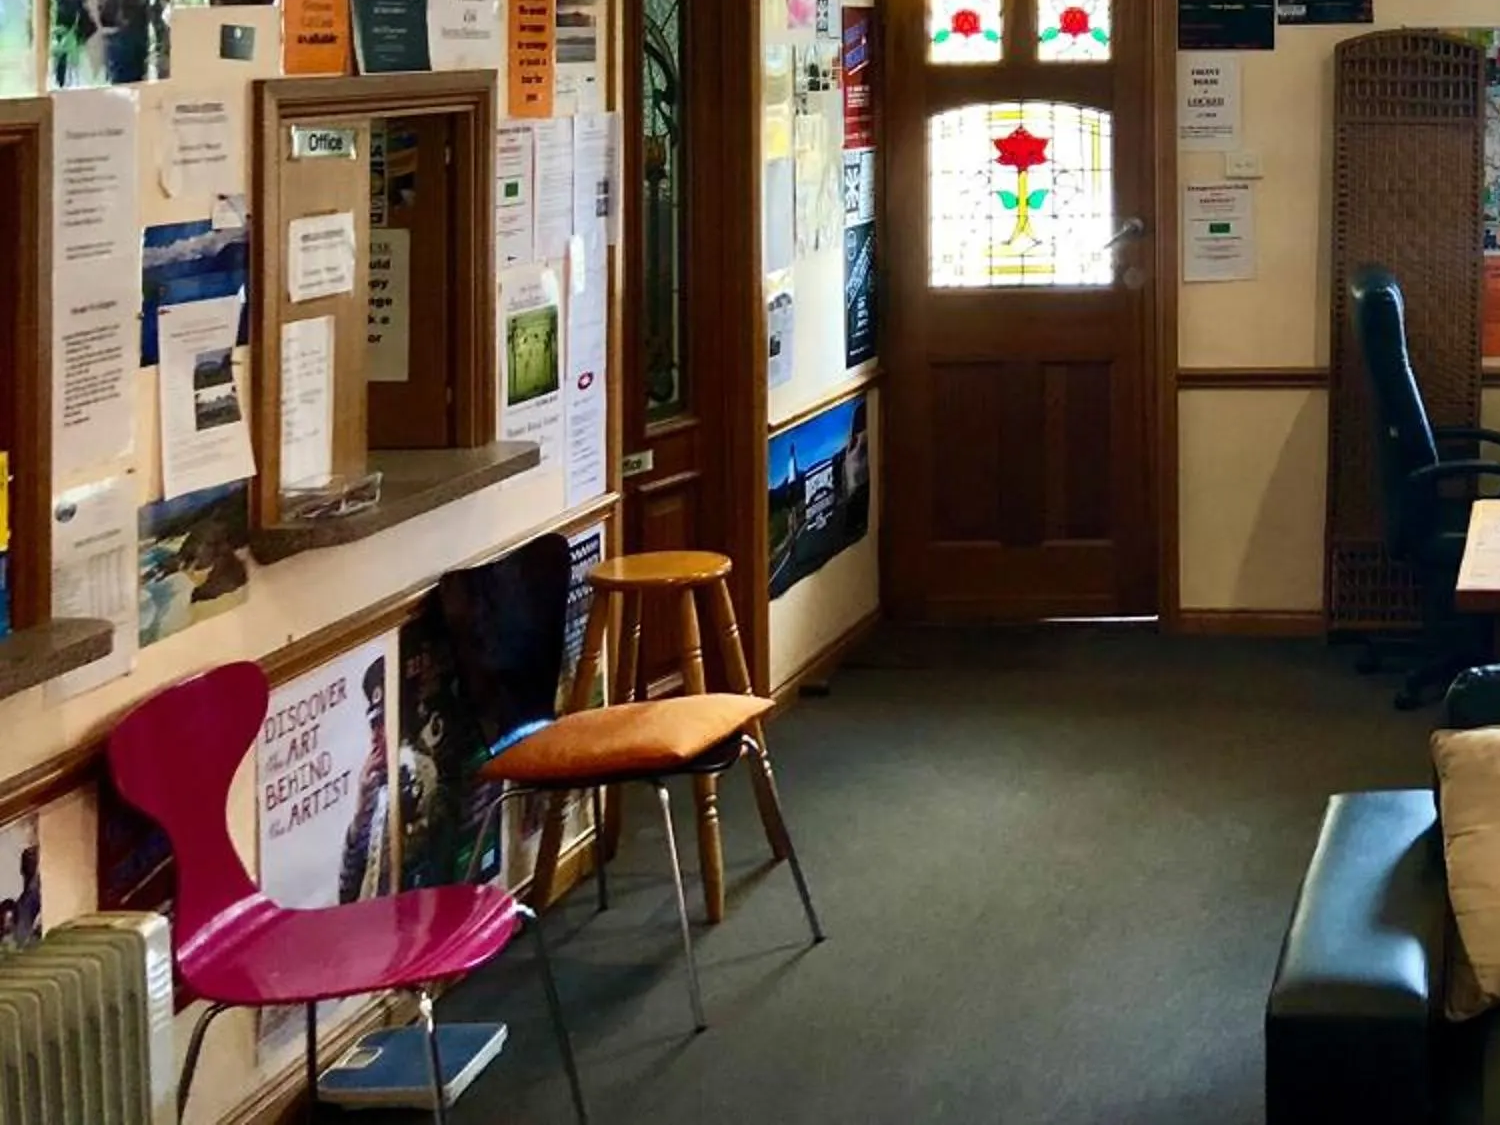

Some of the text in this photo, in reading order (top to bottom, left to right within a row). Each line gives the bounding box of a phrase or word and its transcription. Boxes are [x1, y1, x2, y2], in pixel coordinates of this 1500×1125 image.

[308, 134, 344, 151] Office
[264, 677, 347, 744] DISCOVER
[286, 723, 320, 766] ART
[265, 751, 332, 812] BEHIND
[287, 769, 352, 832] ARTIST
